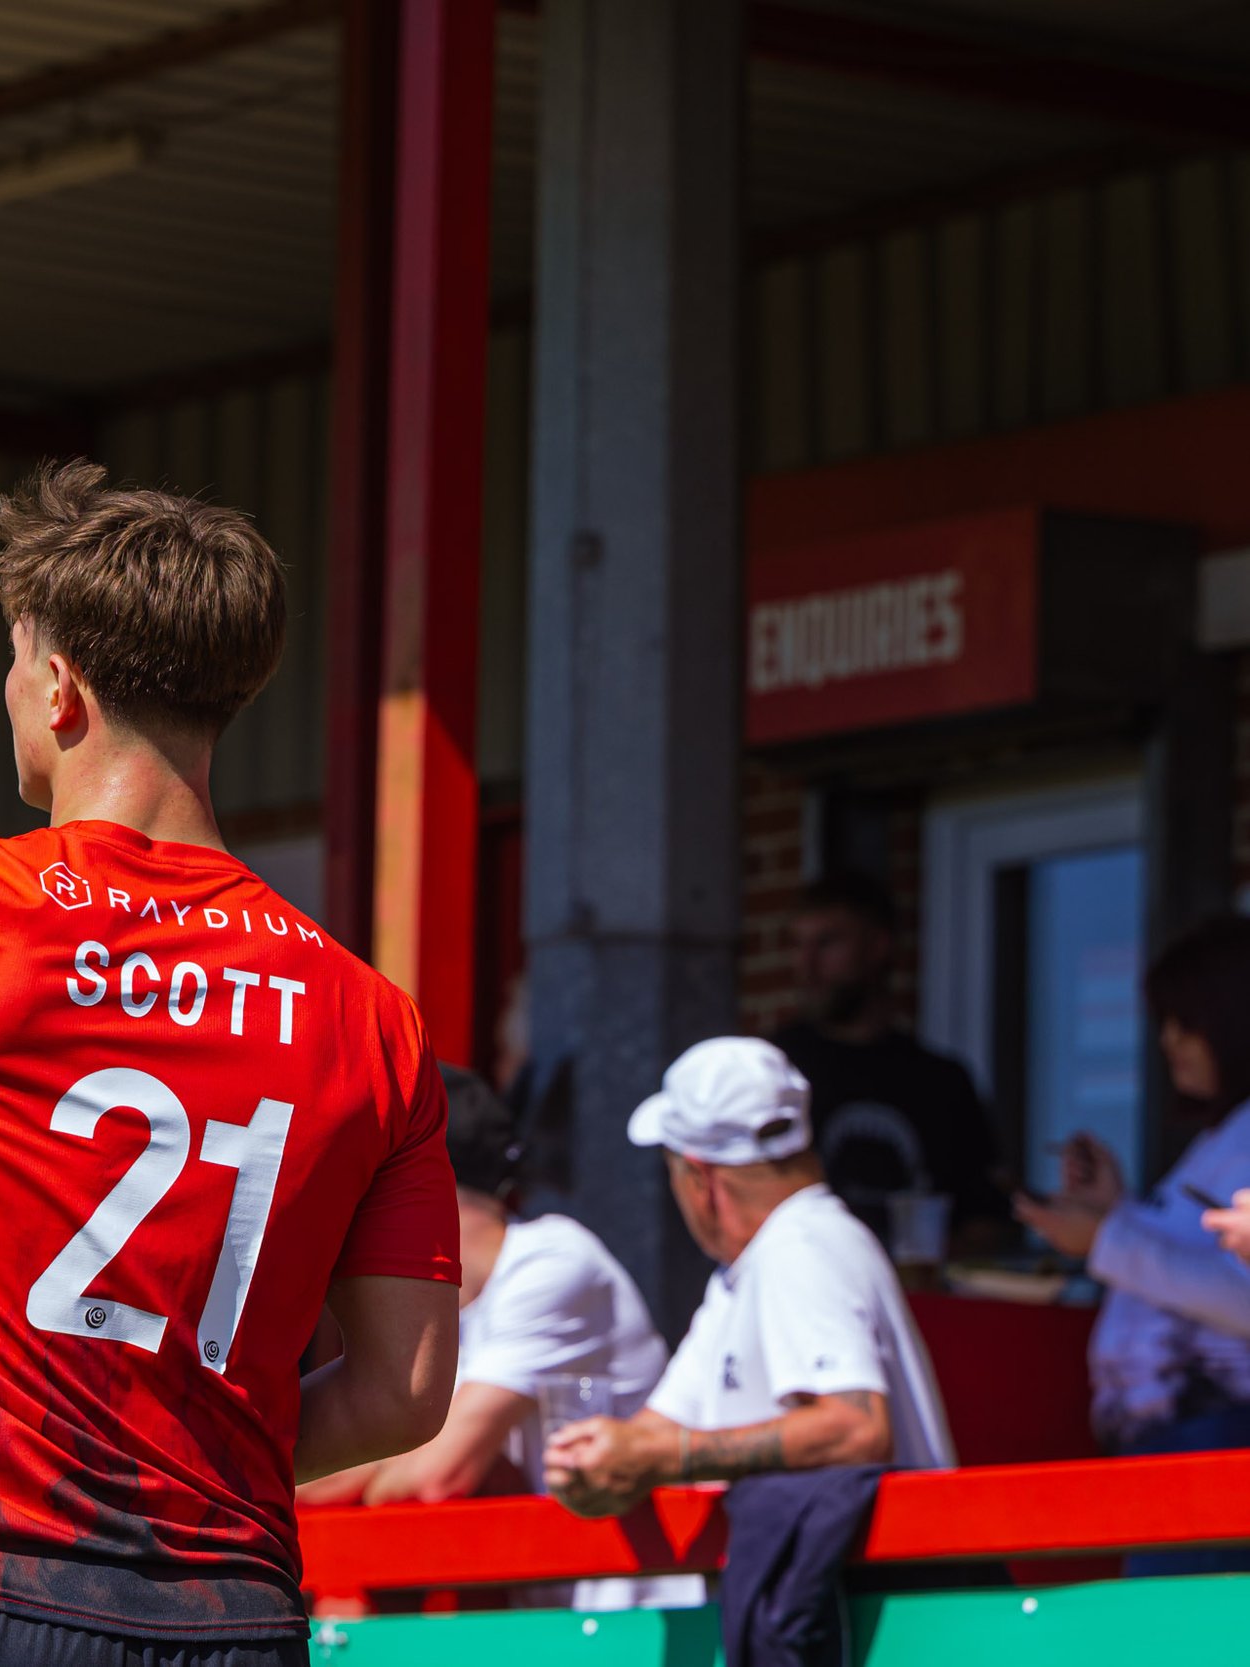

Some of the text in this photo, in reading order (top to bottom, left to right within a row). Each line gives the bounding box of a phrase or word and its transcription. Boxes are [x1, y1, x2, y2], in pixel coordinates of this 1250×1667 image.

[749, 570, 963, 694] ENQUIRIES
[106, 886, 325, 949] RAYDIUM
[65, 939, 306, 1046] SCOTT
[24, 1066, 295, 1376] 21
